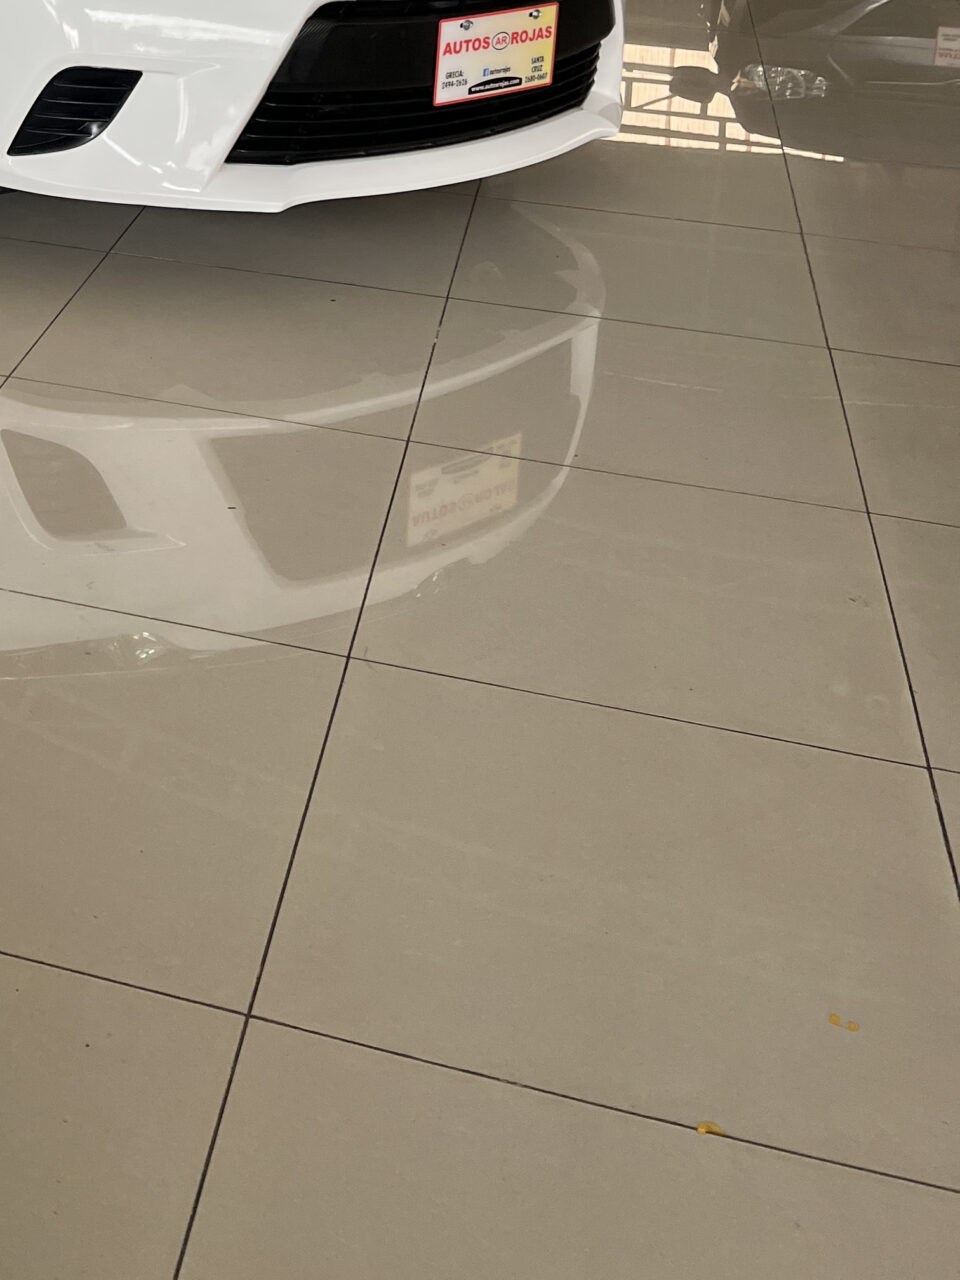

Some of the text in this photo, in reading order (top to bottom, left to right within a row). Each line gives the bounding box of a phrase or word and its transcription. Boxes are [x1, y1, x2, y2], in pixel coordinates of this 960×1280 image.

[443, 26, 553, 56] AUTOS AR ROJAS
